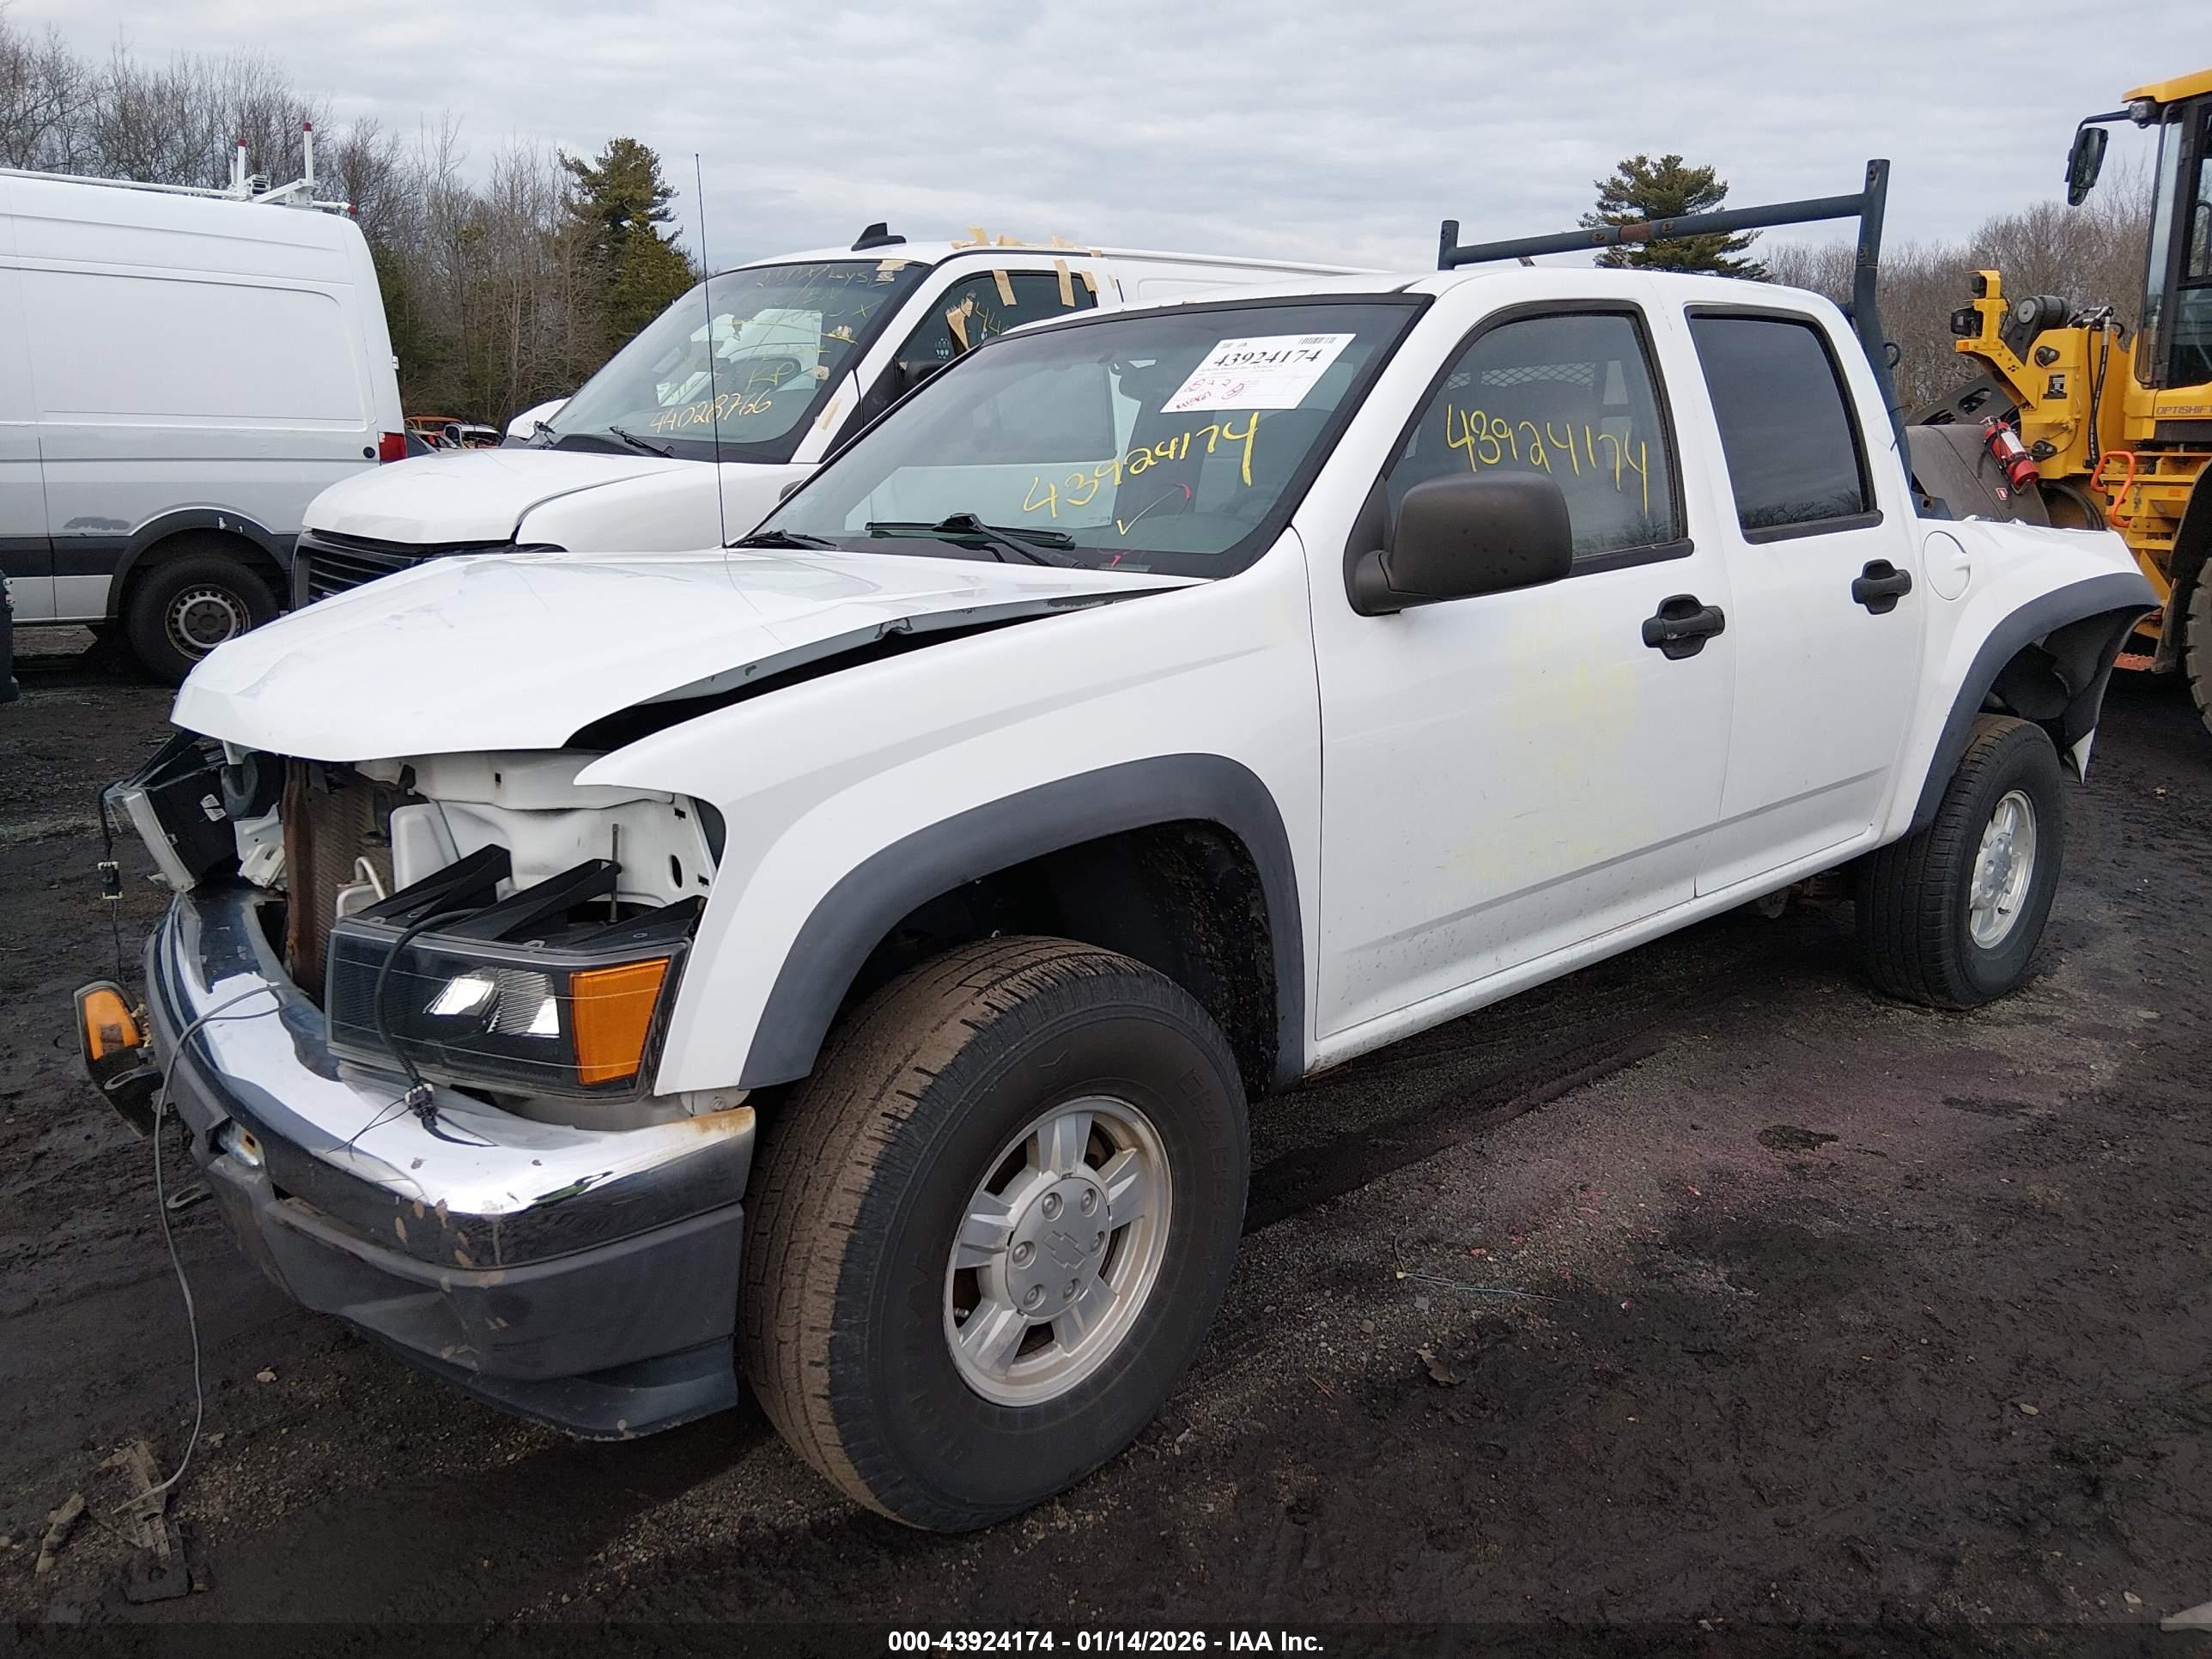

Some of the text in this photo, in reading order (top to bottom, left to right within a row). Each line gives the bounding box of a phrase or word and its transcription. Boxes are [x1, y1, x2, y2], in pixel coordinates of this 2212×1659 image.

[1214, 349, 1322, 367] 43924174
[650, 390, 771, 433] 44028766
[1024, 412, 1259, 518] 43924174
[1446, 404, 1648, 519] 43924174
